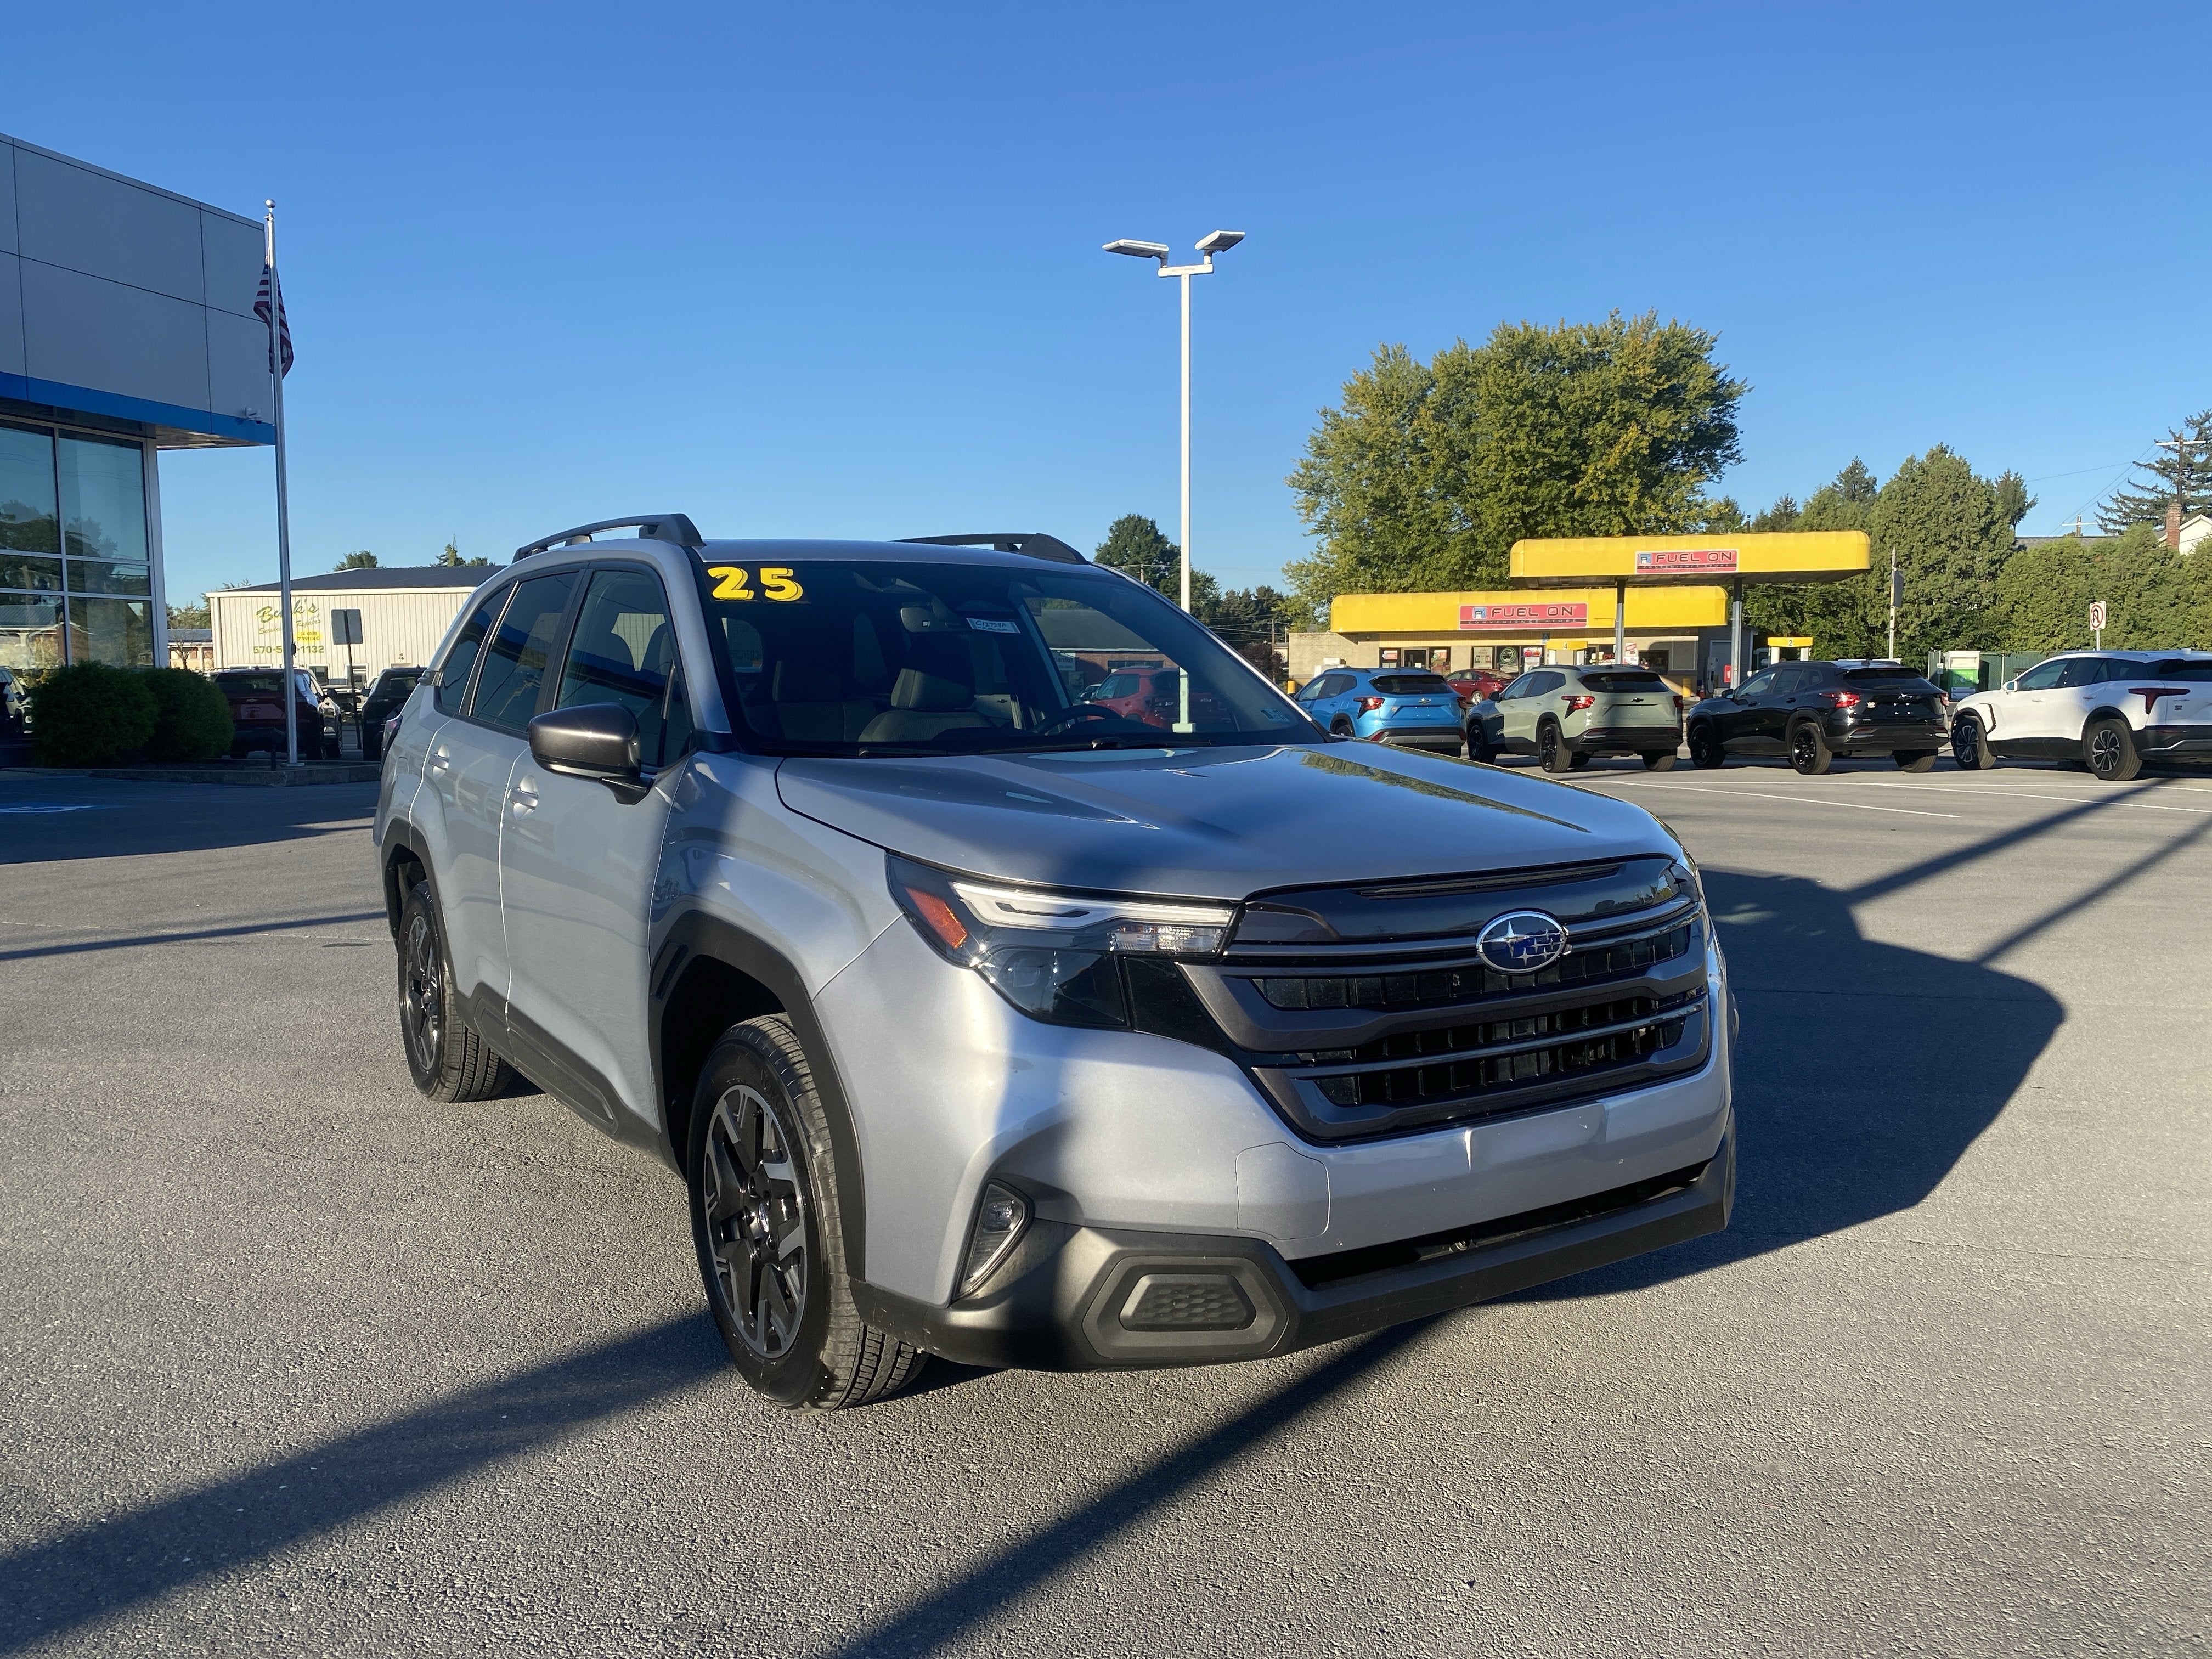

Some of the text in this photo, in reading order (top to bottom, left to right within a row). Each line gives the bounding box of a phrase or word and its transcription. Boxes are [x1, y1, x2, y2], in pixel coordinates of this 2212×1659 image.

[1656, 552, 1732, 563] FUEL ON
[707, 566, 804, 602] 25
[256, 599, 319, 623] Buk's
[1491, 606, 1573, 617] FUEL ON
[253, 645, 325, 654] 570-5-1132
